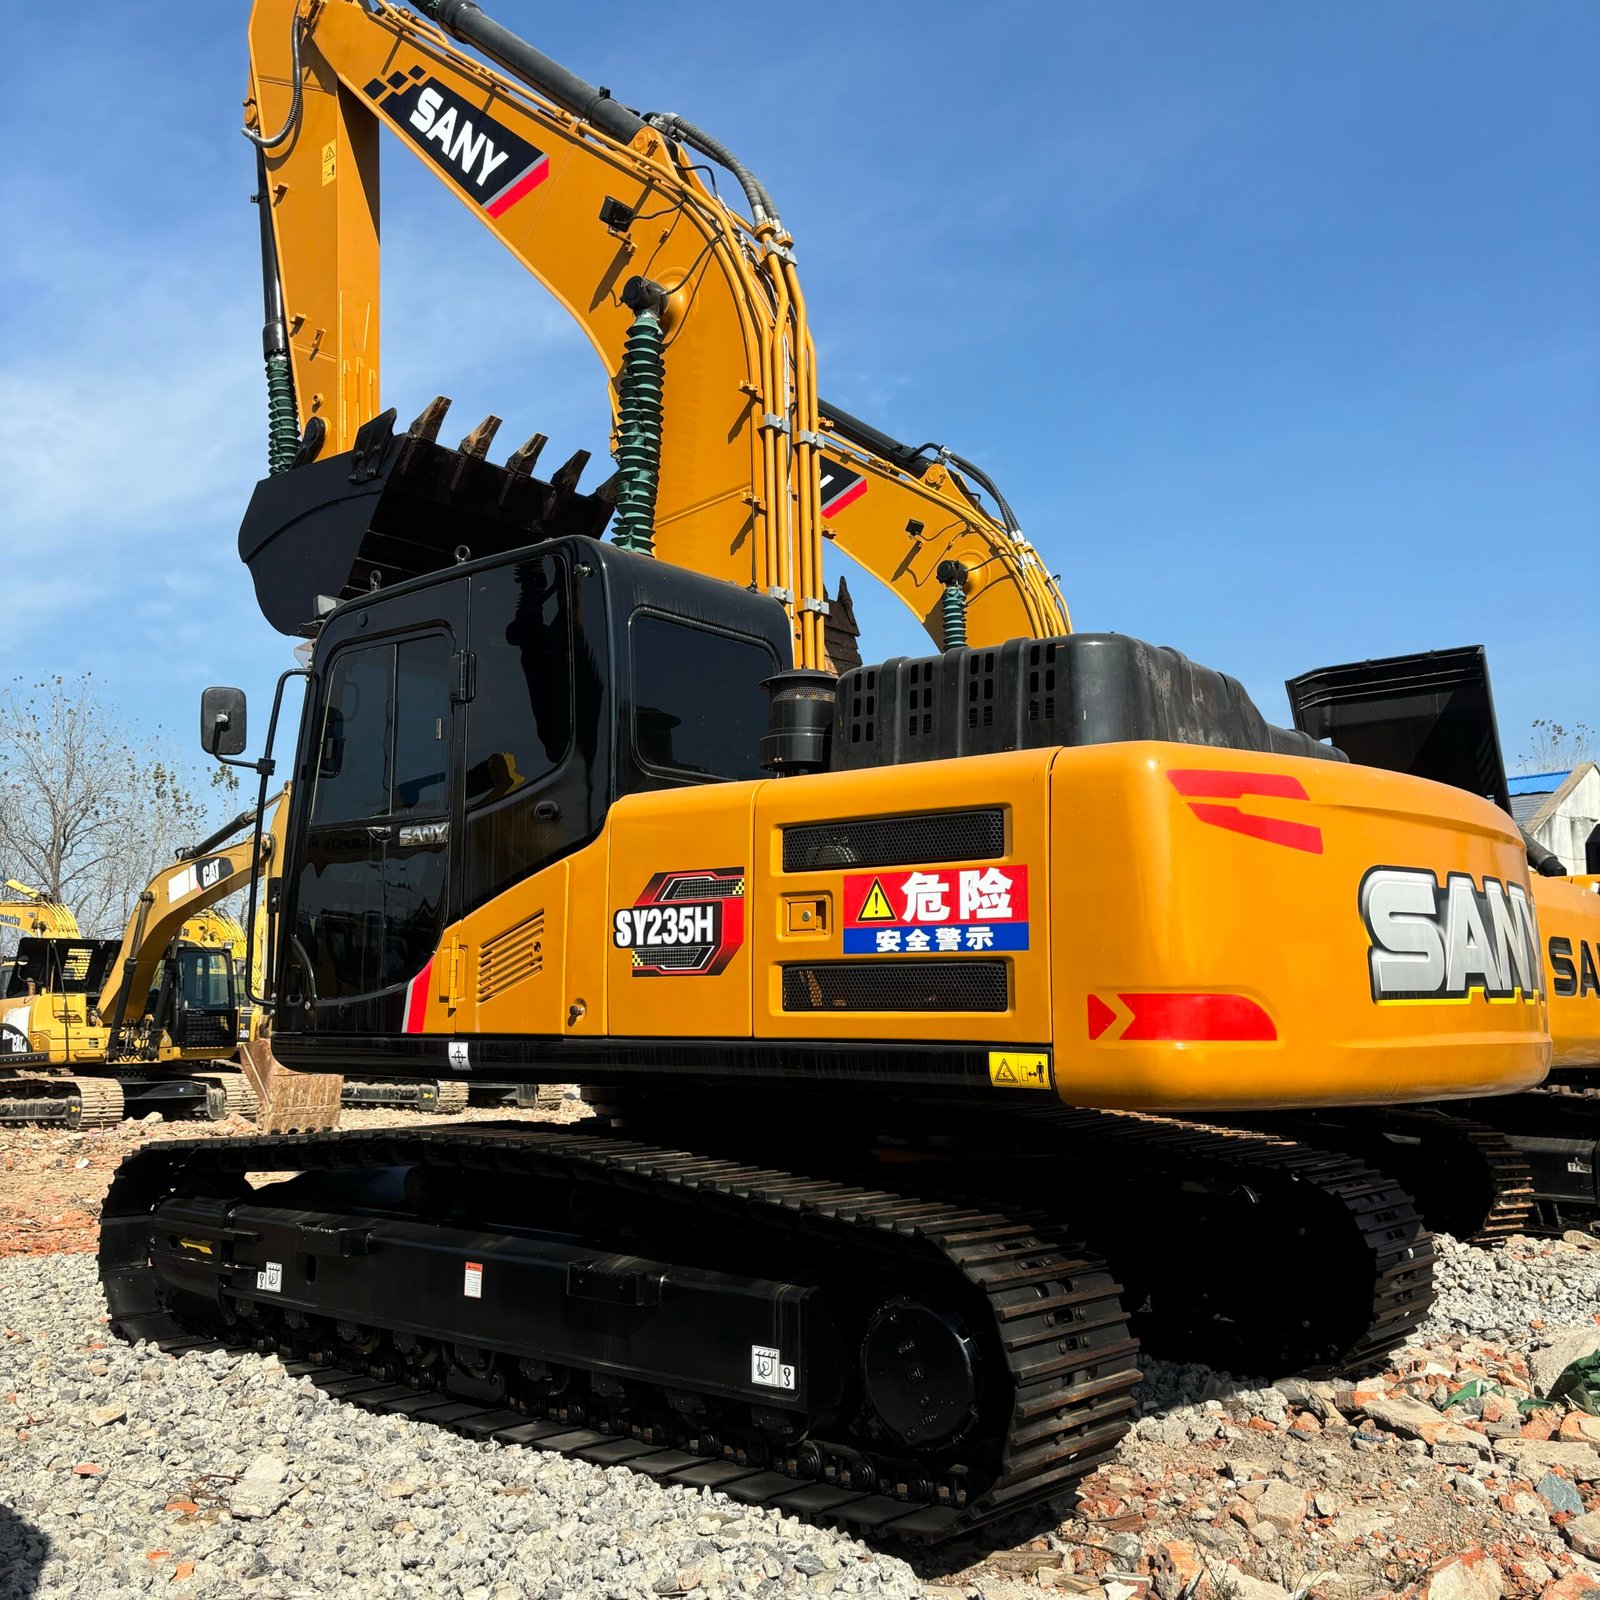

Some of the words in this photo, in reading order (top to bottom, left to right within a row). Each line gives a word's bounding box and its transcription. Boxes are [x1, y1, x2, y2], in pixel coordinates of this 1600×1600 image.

[409, 87, 509, 187] SANY
[202, 859, 220, 887] CAT
[901, 867, 1013, 923] 危险
[615, 905, 714, 947] SY235H
[876, 926, 994, 952] 安全警示
[1548, 936, 1600, 998] SA
